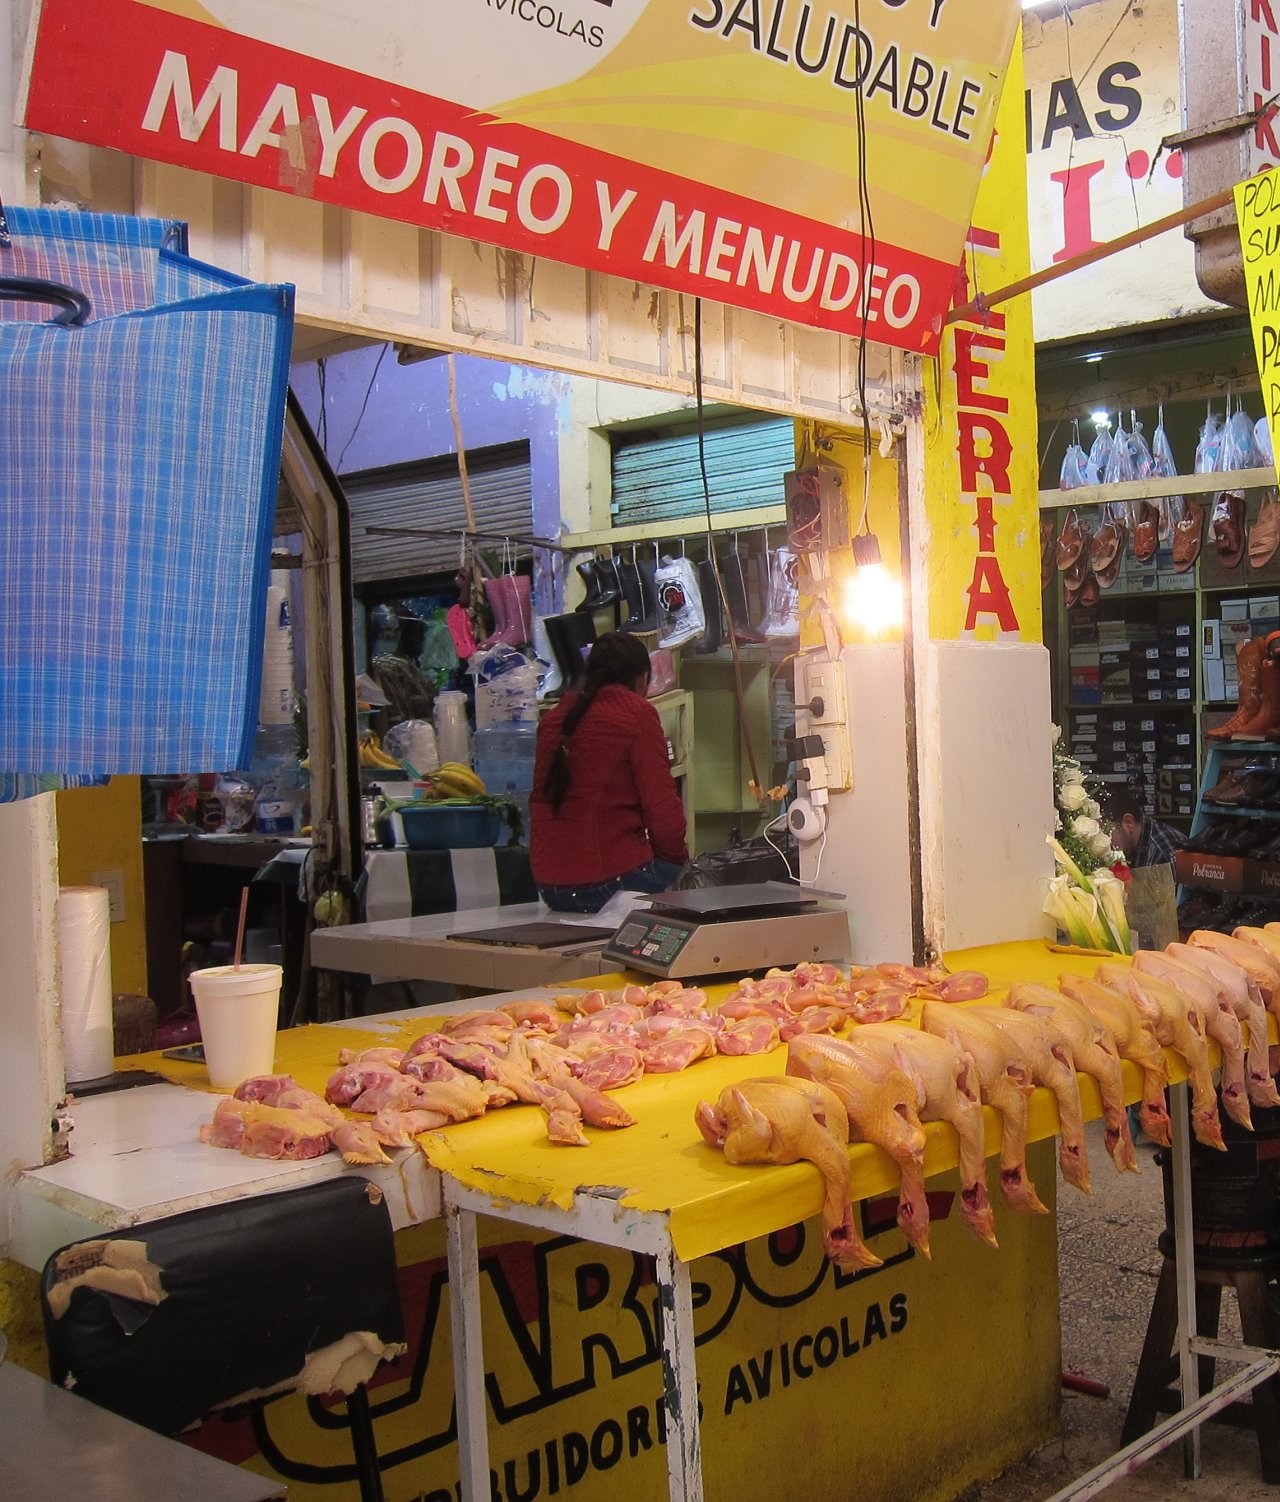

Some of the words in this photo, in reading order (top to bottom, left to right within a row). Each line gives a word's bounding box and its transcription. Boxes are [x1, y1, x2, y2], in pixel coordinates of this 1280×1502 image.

[141, 51, 573, 235] MAYOREO
[595, 180, 638, 253] Y
[642, 200, 920, 329] MENUDEO
[724, 1290, 908, 1417] AVICOLAS
